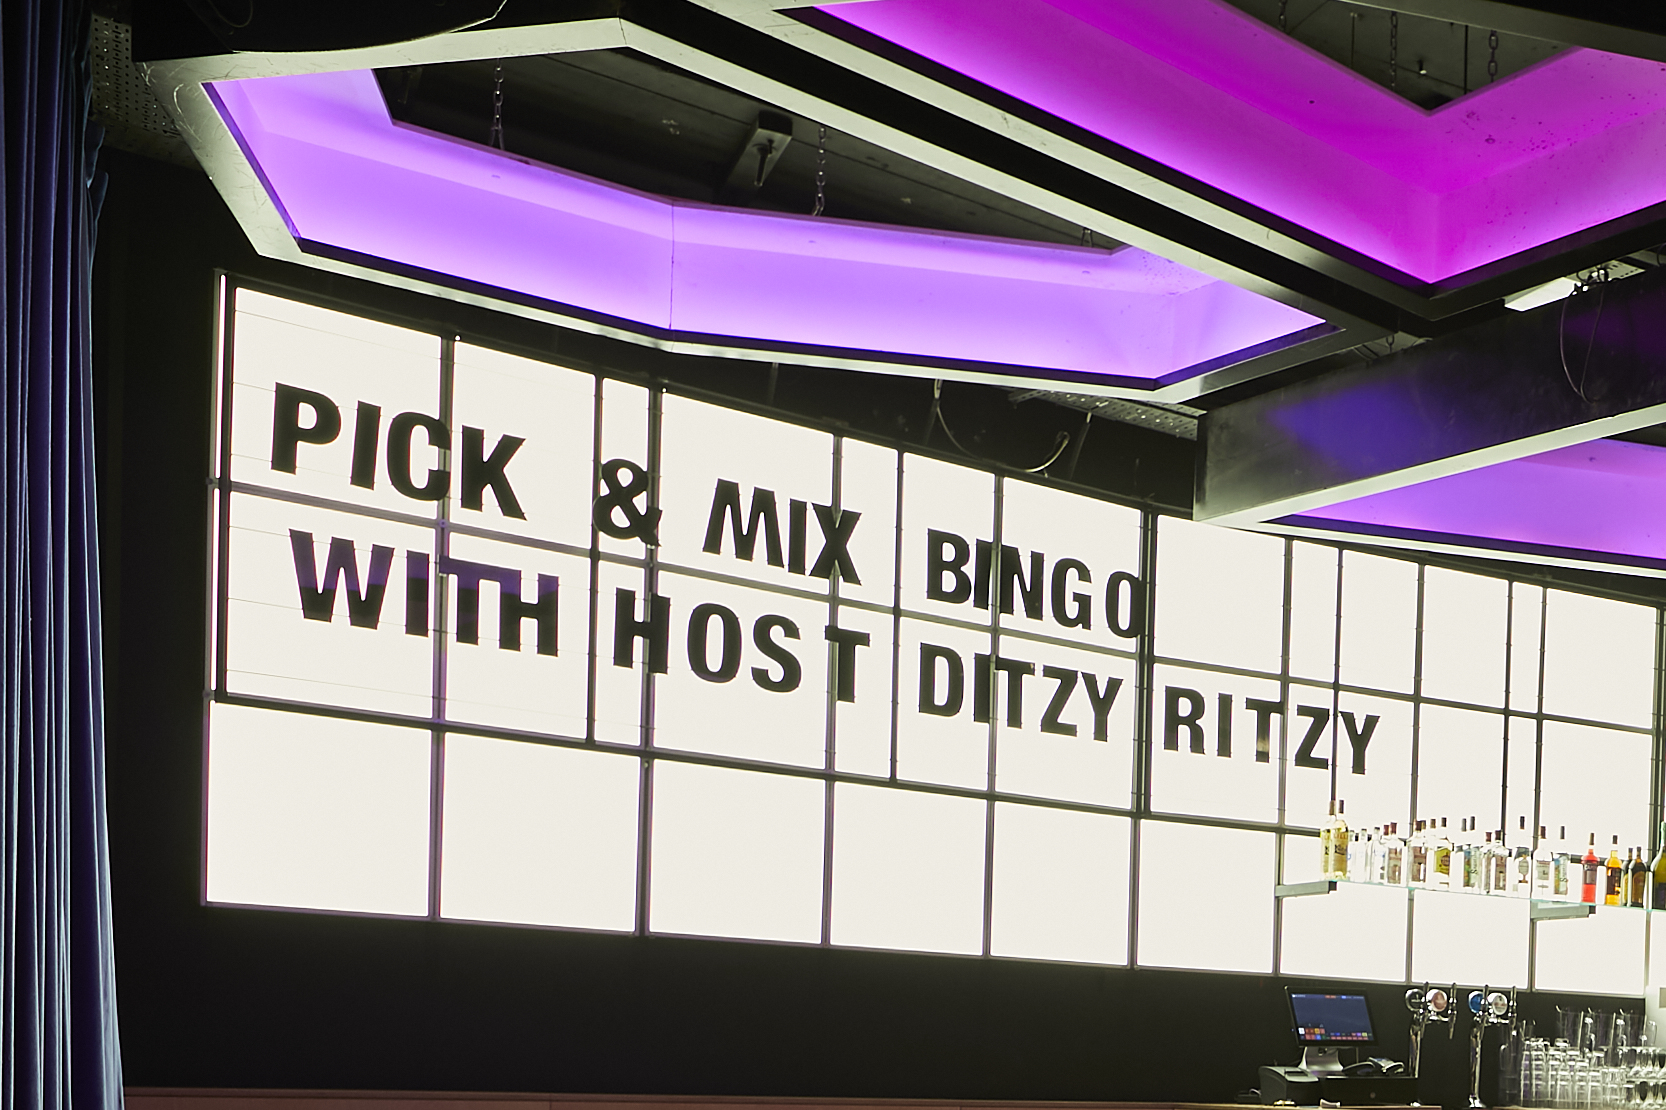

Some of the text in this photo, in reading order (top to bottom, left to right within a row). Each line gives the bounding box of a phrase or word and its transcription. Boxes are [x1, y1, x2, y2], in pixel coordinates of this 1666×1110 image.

[271, 382, 1142, 639] PICK & MIX BINGO
[289, 529, 1380, 775] WITH HOST DITZY RITZY
